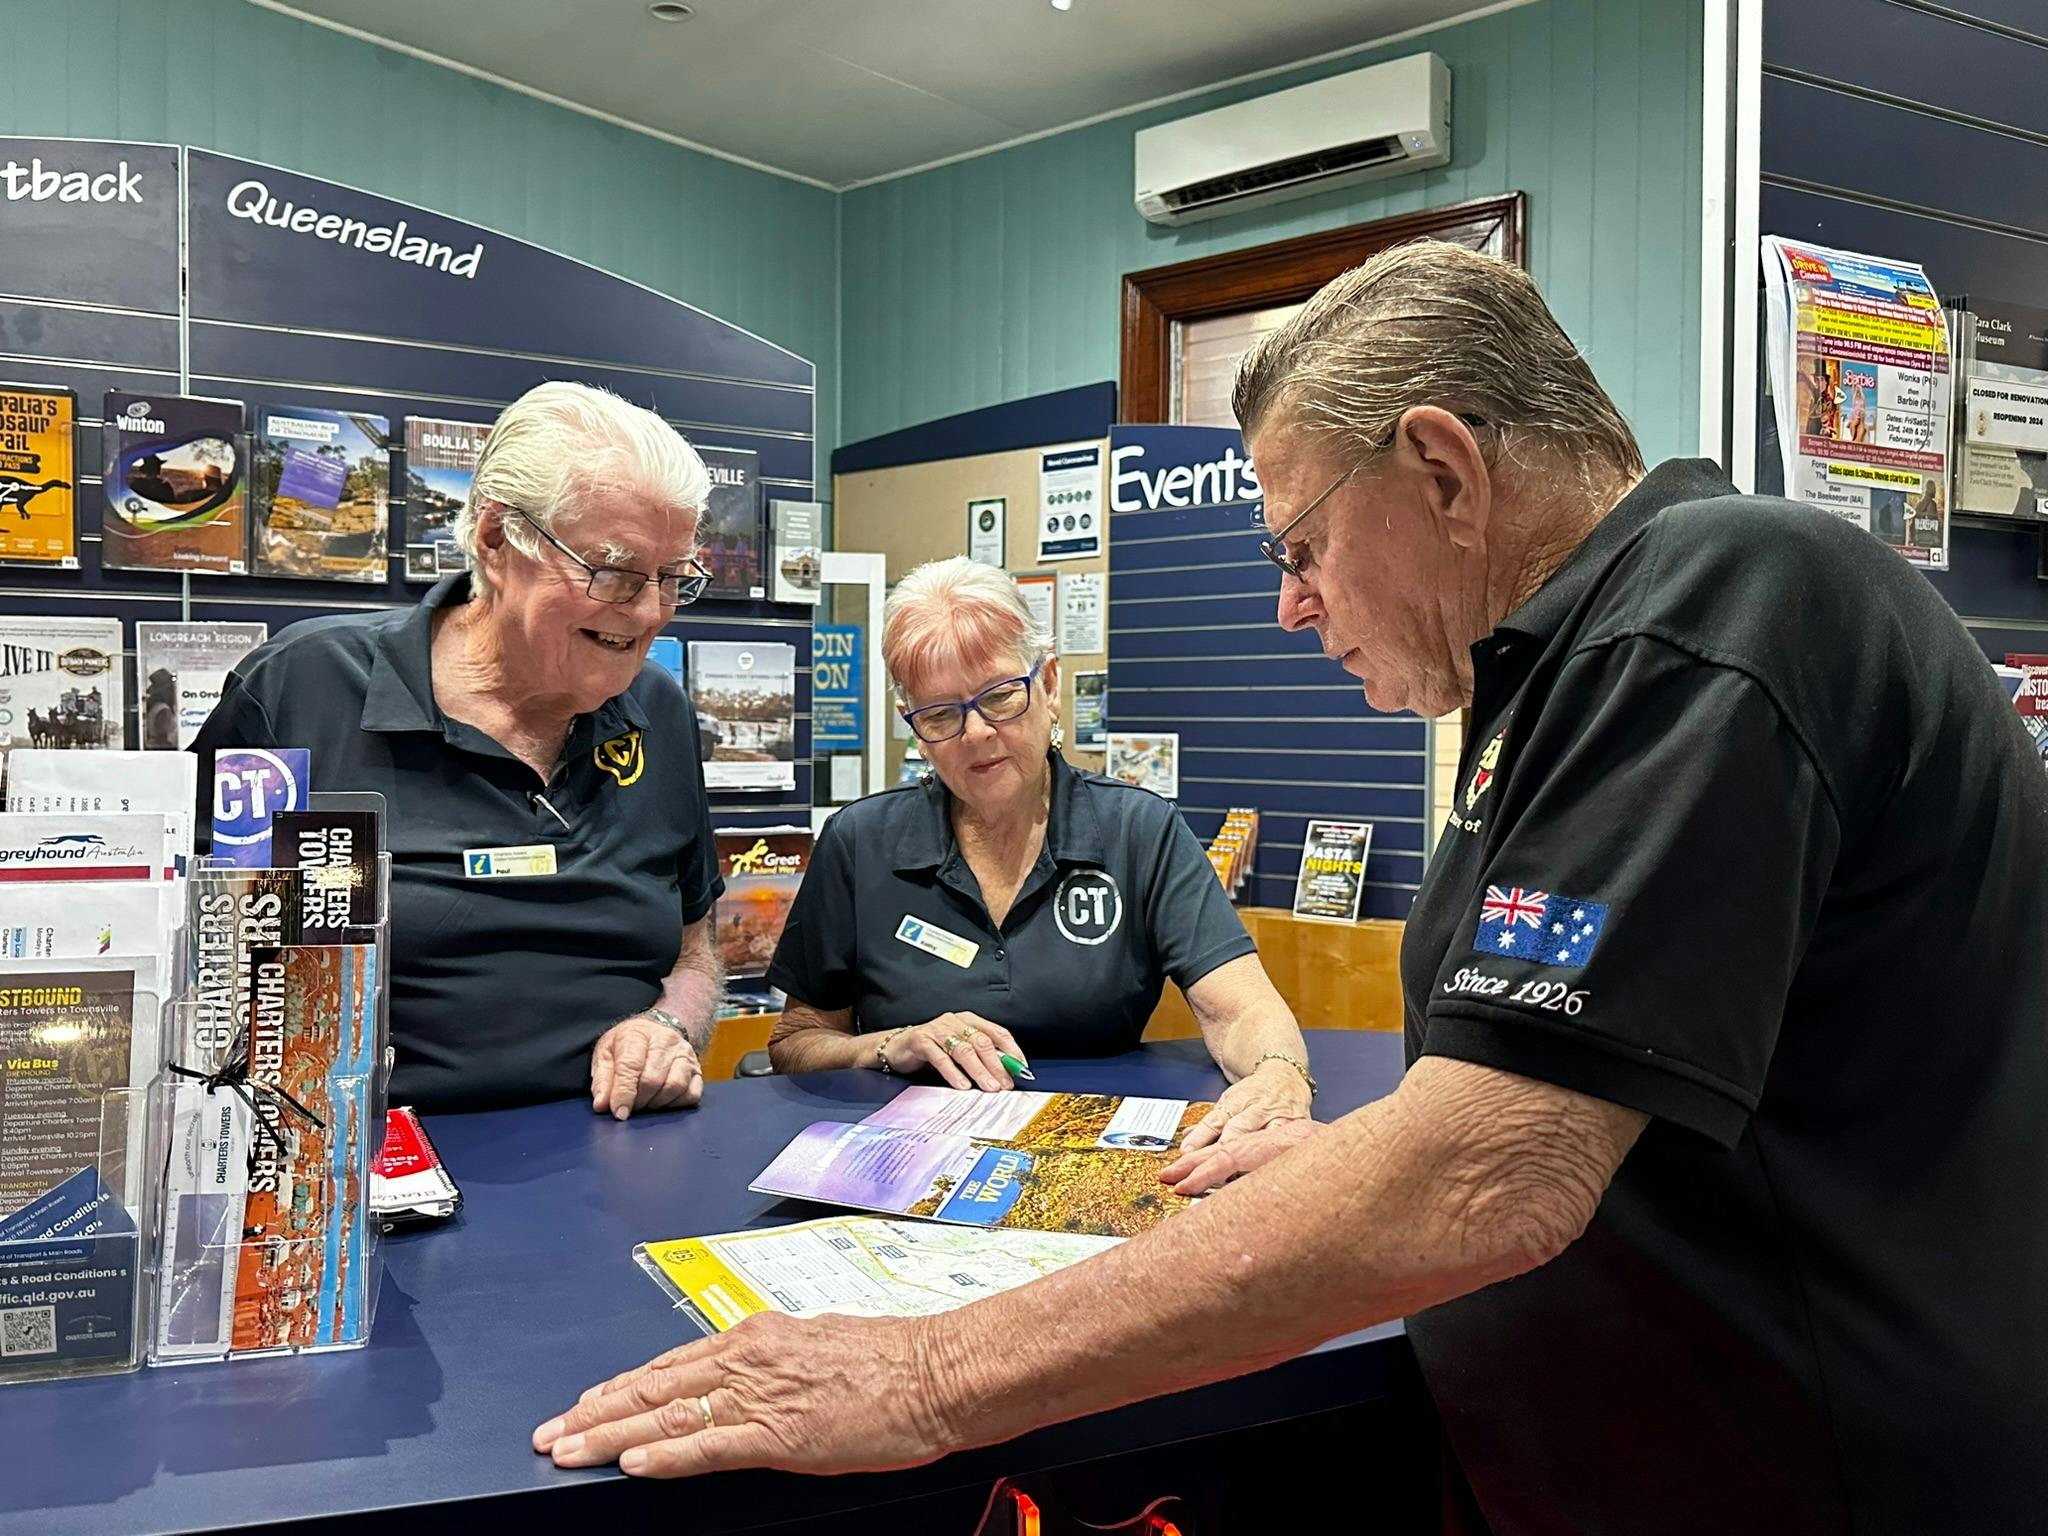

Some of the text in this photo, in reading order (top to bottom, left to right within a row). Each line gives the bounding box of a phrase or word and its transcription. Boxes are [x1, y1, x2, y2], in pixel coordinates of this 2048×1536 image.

[226, 180, 484, 280] Queensland
[1990, 319, 2012, 332] Clark
[1898, 371, 1920, 383] Wonka
[1897, 395, 1919, 407] Barbie
[1973, 388, 1996, 399] CLOSED
[1997, 391, 2009, 400] FOR
[116, 414, 165, 434] Winton
[1993, 412, 2027, 424] REOPENING
[423, 433, 470, 450] BOULIA
[1889, 434, 1913, 446] February
[1110, 445, 1264, 513] Events
[1805, 489, 1816, 498] The
[1817, 491, 1848, 502] Beekeeper
[1932, 551, 1942, 563] C1
[150, 632, 252, 644] LONGREACH REGION
[36, 648, 54, 672] IT
[182, 690, 222, 699] On Ord
[213, 768, 272, 822] CT
[1464, 819, 1482, 833] of
[0, 846, 86, 862] greyhound
[764, 853, 801, 867] Great
[1307, 847, 1352, 861] PASTA
[1306, 858, 1362, 875] NIGHTS
[326, 827, 353, 929] CHAERS
[1067, 886, 1109, 926] CT
[195, 893, 236, 1050] CHARTERS
[0, 987, 82, 1007] STBOUND
[1443, 967, 1590, 1016] Since 1926
[20, 1006, 55, 1015] Towers
[57, 1006, 67, 1014] to
[70, 1004, 119, 1014] Townsville
[255, 962, 286, 1086] CHARTERS
[7, 1058, 59, 1070] Via Bus
[4, 1100, 29, 1108] Arrival
[3, 1120, 41, 1128] Departure
[216, 1105, 232, 1184] CHARTERS TOWERS
[248, 1092, 281, 1193] OWERS
[959, 1154, 1020, 1204] THE WORLD
[53, 1192, 110, 1232] Conditions
[14, 1251, 42, 1259] Transport
[10, 1267, 117, 1285] & Road Conditions
